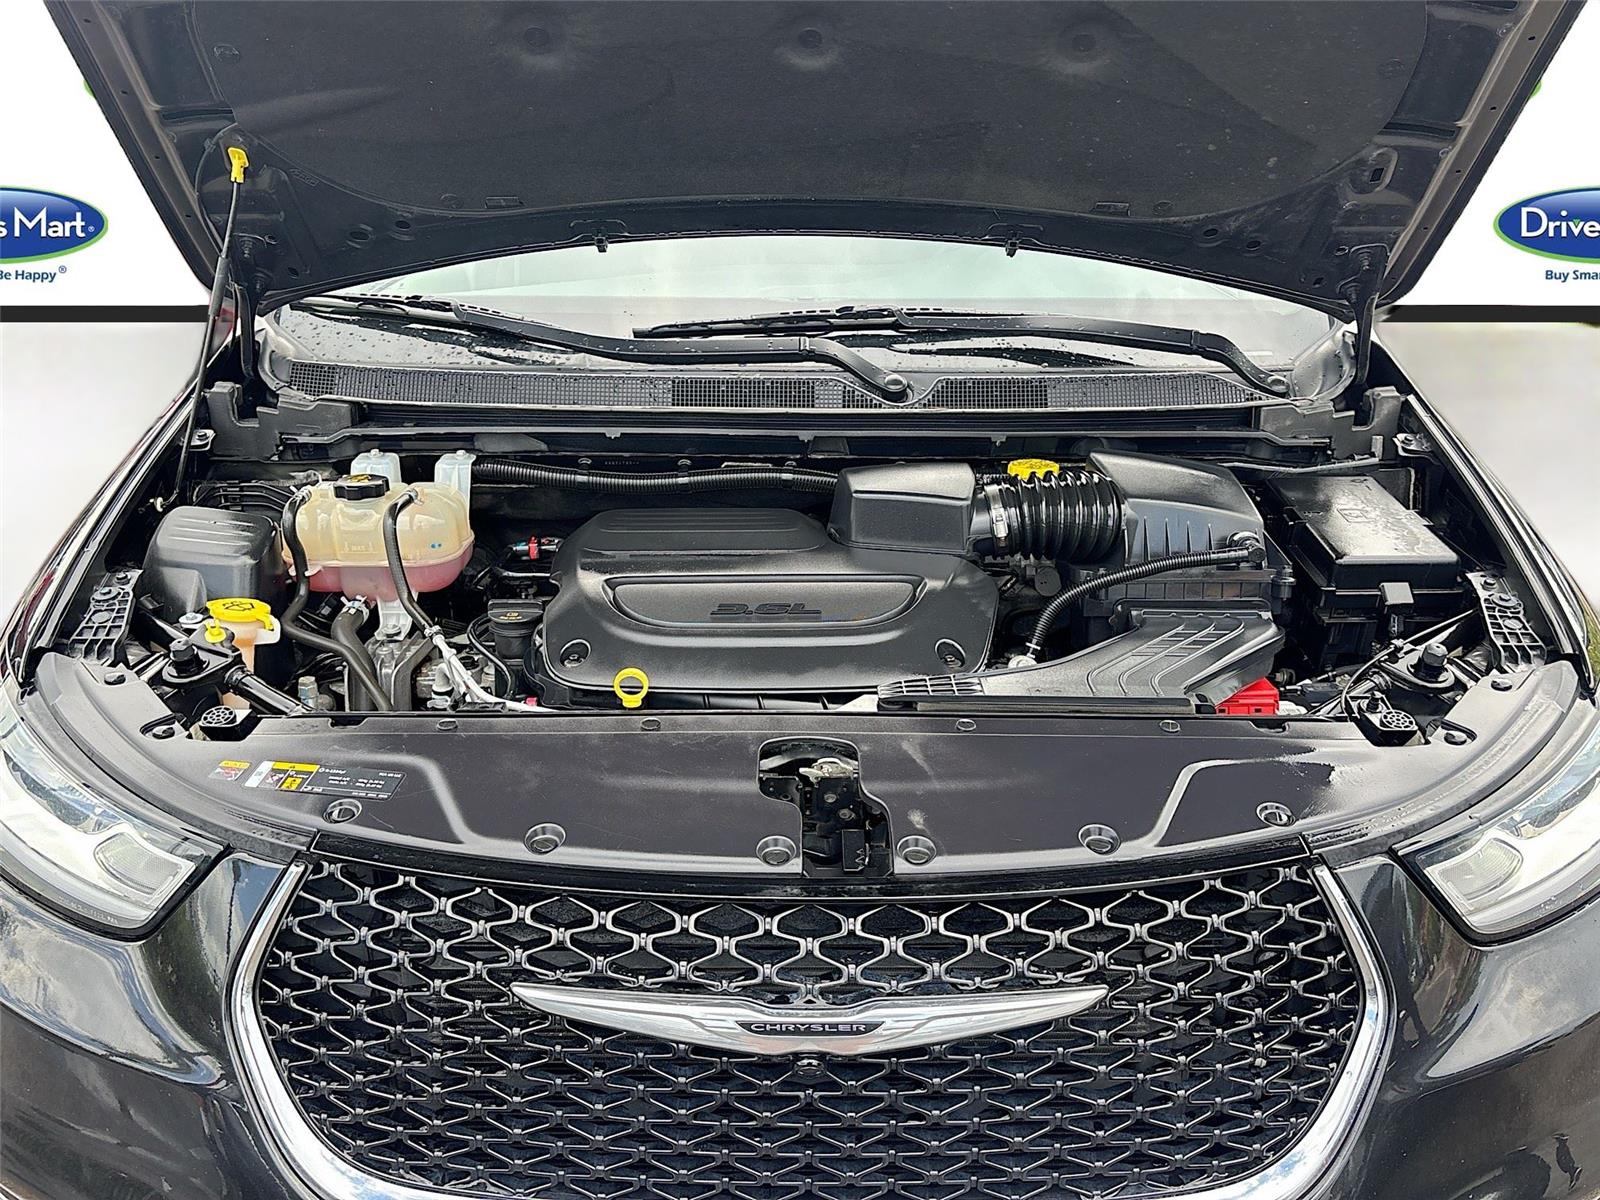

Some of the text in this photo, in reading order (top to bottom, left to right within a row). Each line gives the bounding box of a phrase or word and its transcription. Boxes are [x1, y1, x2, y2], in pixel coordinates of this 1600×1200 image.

[1545, 270, 1600, 283] Buy Sma
[710, 603, 822, 615] 3.6L
[750, 1023, 866, 1032] CHRYSLER
